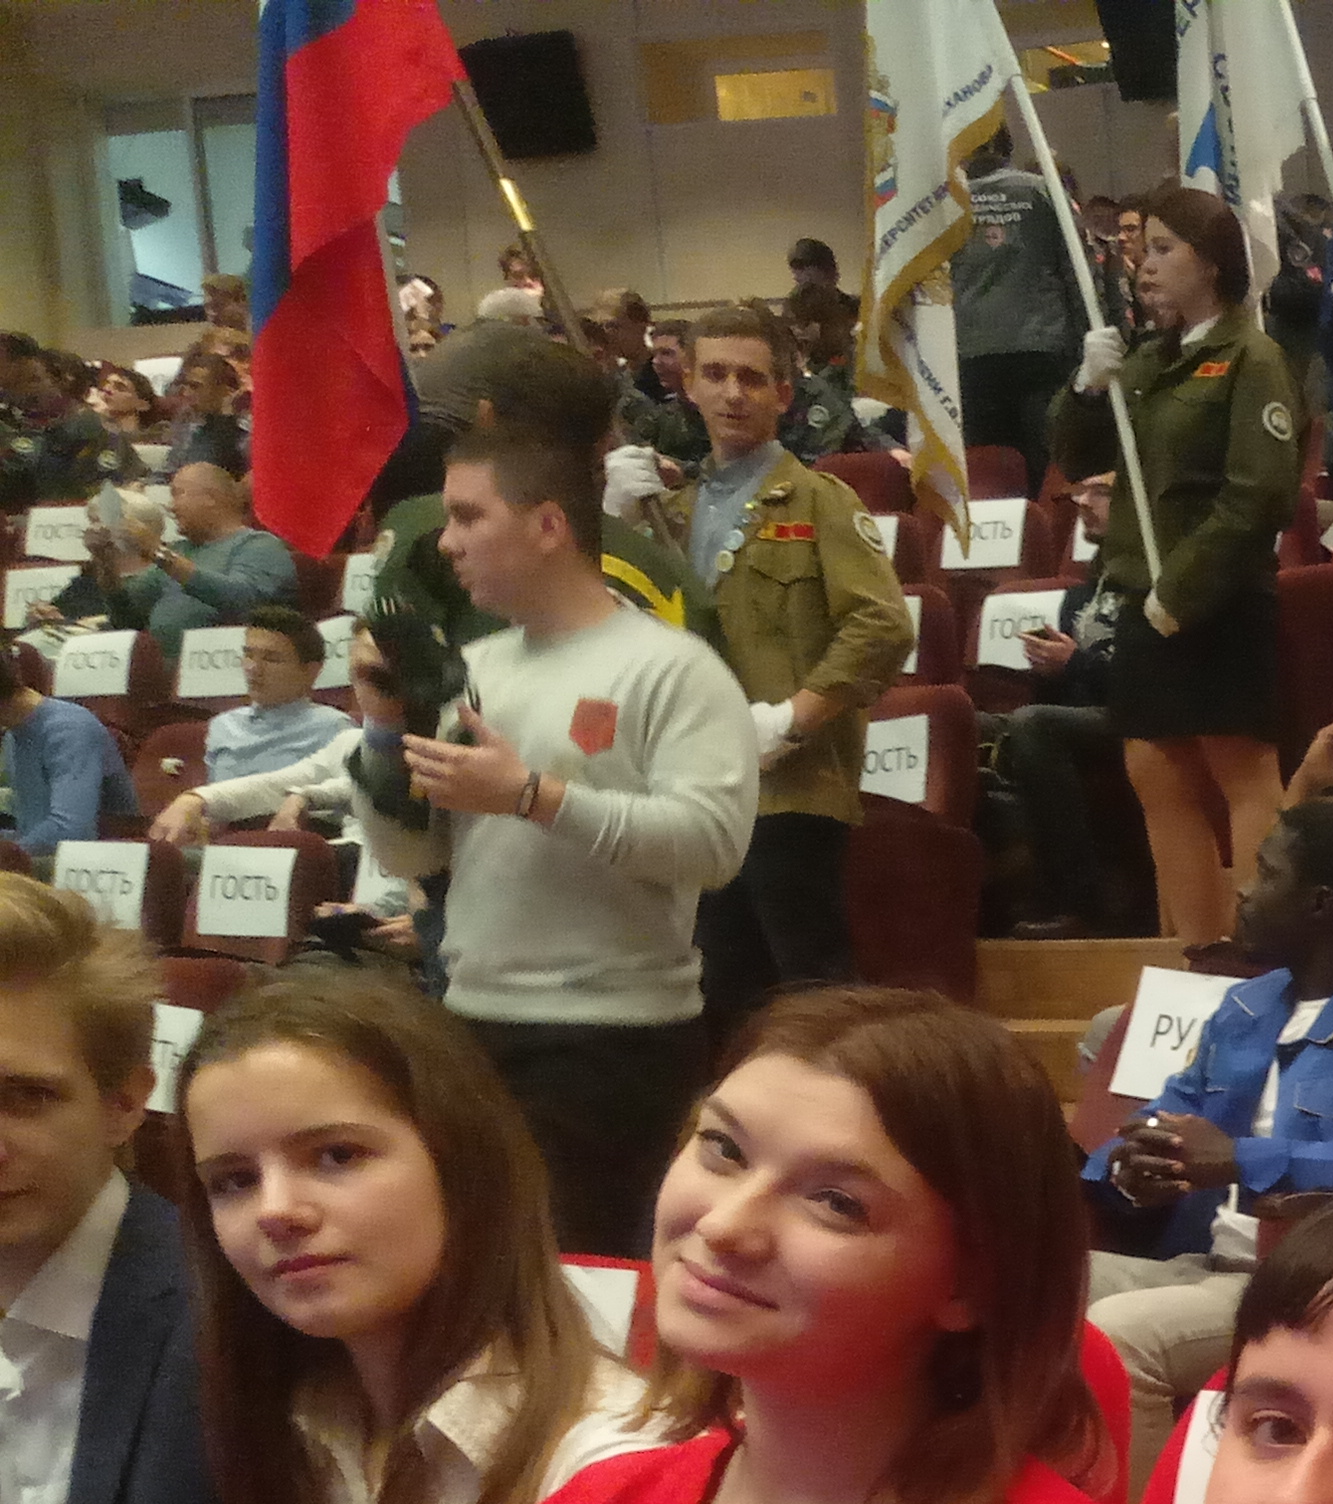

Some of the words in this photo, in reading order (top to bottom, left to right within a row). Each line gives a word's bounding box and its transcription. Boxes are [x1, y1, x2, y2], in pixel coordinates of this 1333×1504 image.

[64, 649, 121, 670] ГОСТЬ
[864, 746, 919, 775] ОСТЬ
[64, 867, 134, 895] ГОСТЬ
[210, 873, 281, 901] ГОСТЬ
[1149, 1013, 1197, 1051] РУ
